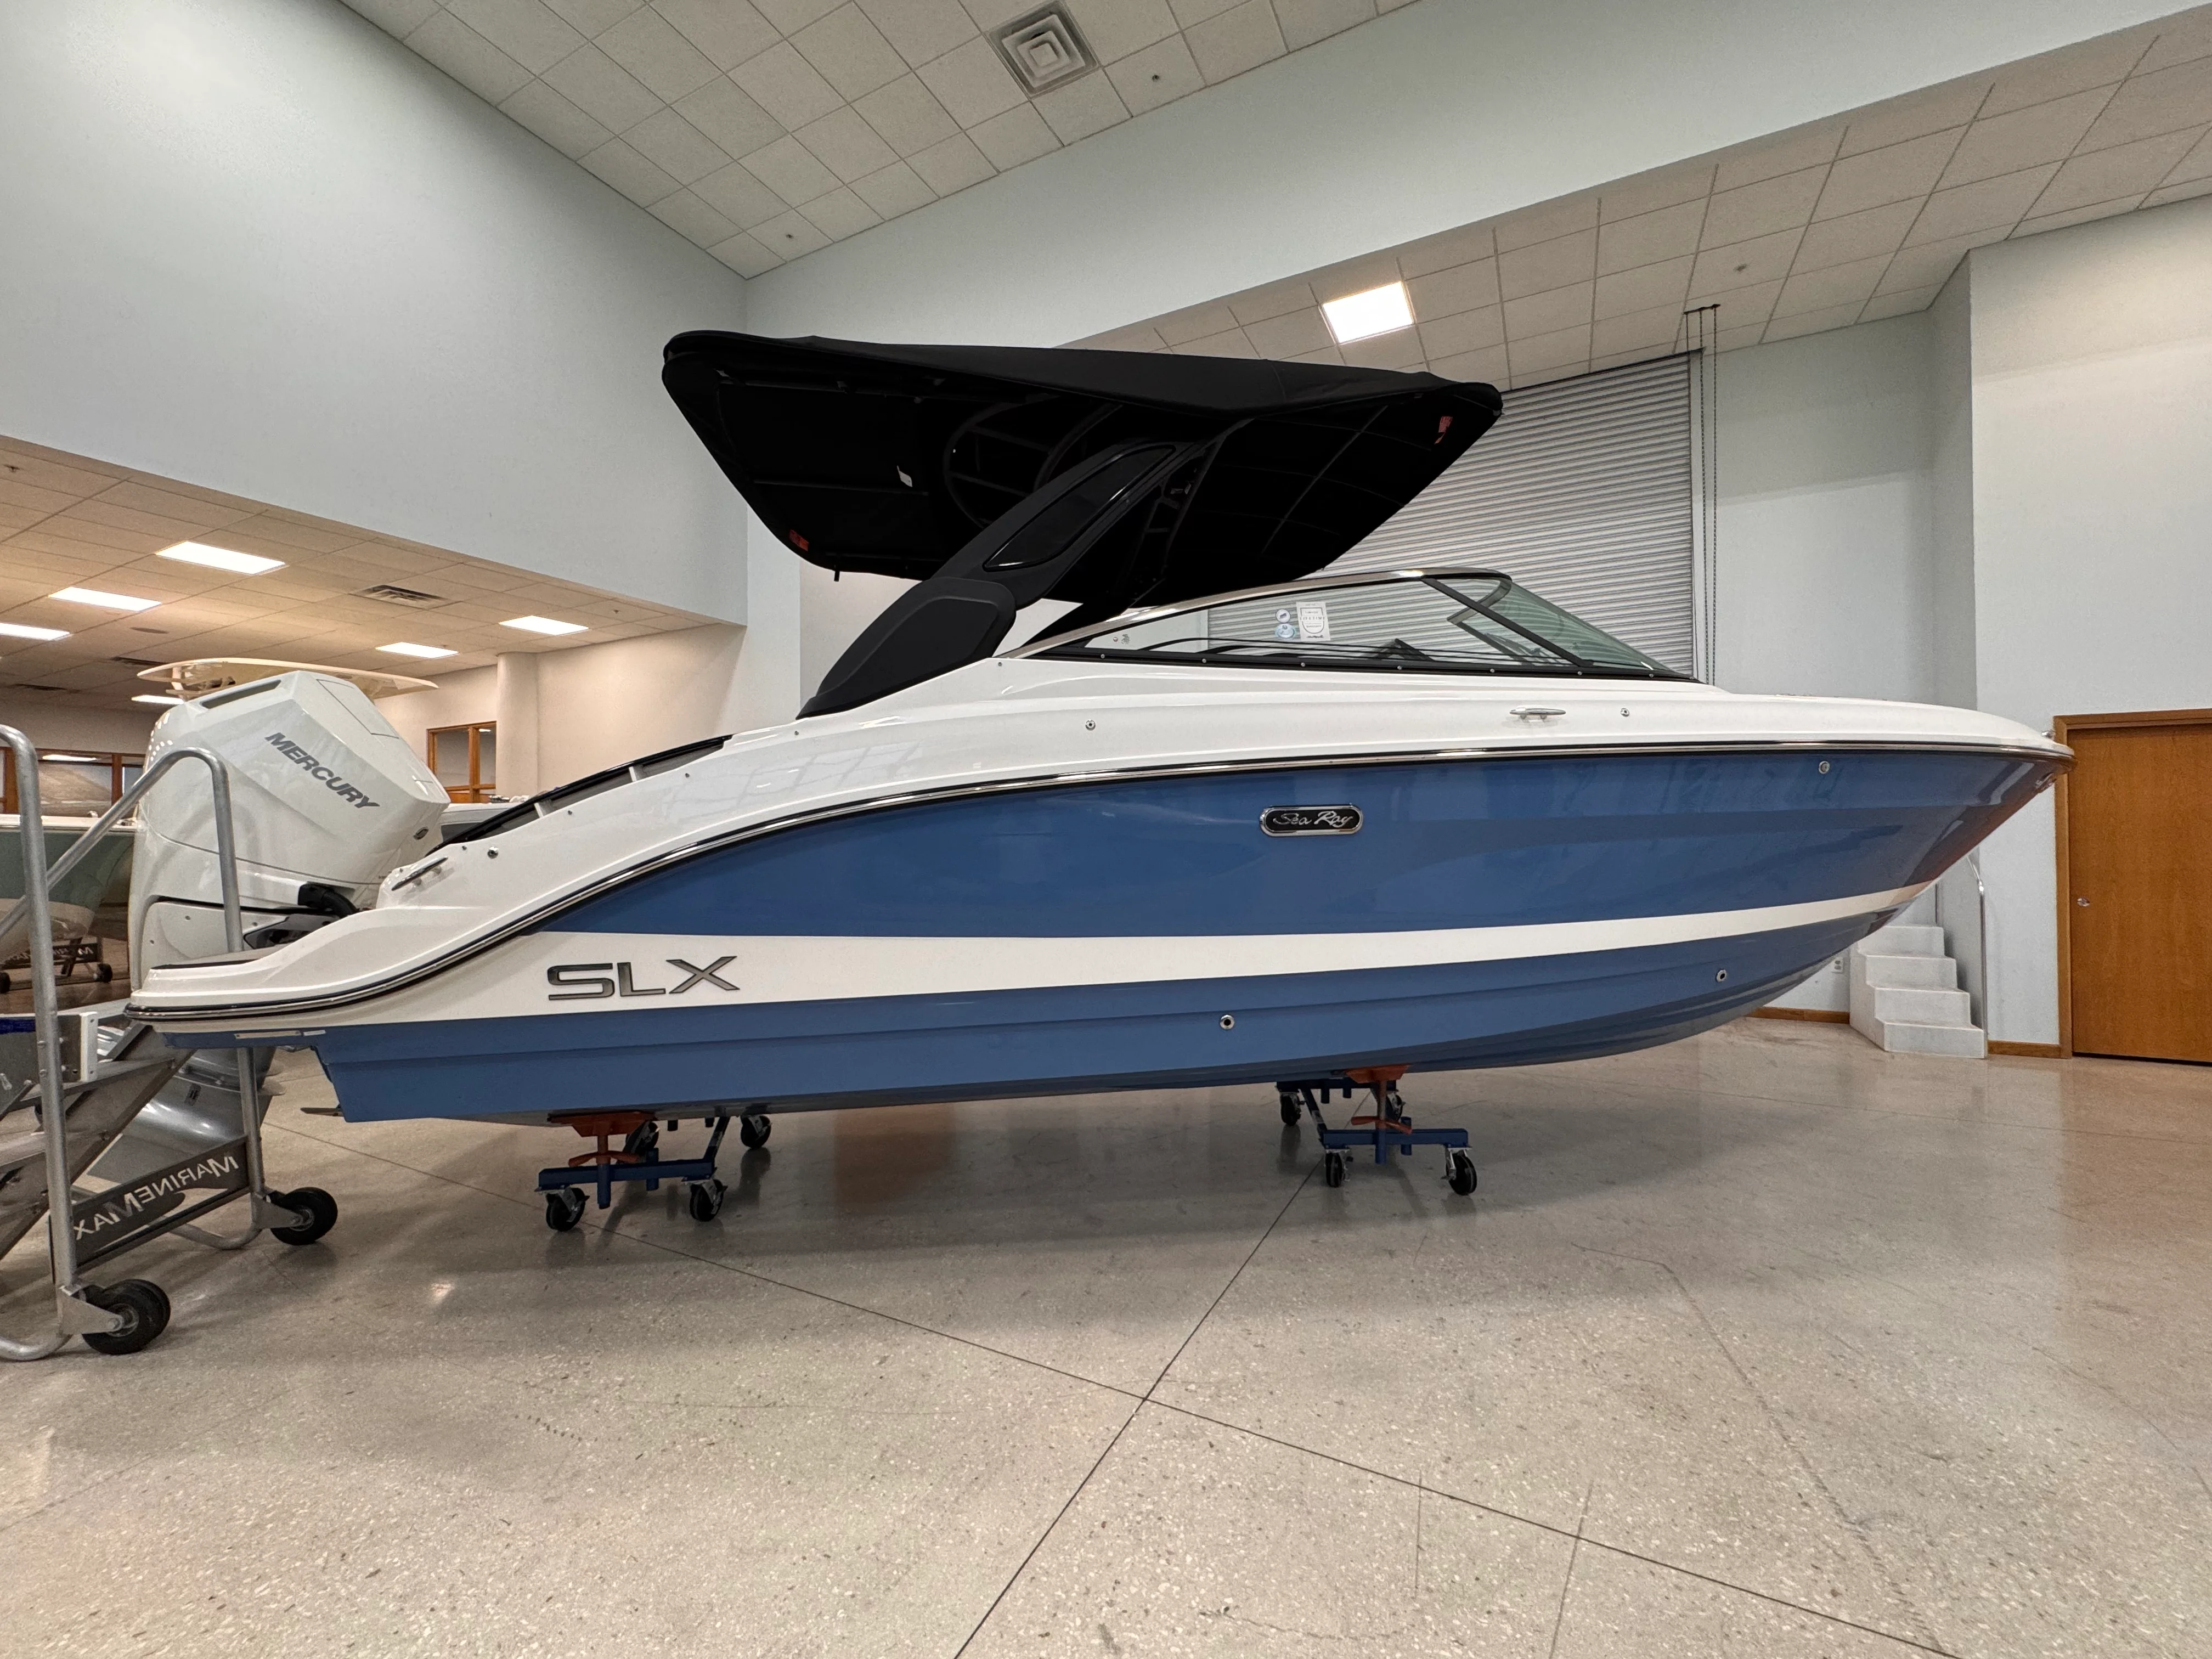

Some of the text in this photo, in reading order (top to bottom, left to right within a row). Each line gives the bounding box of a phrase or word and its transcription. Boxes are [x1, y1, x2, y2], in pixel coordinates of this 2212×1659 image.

[264, 732, 380, 808] MERCURY
[1273, 811, 1353, 828] Sea Ray
[547, 956, 741, 1001] SLX
